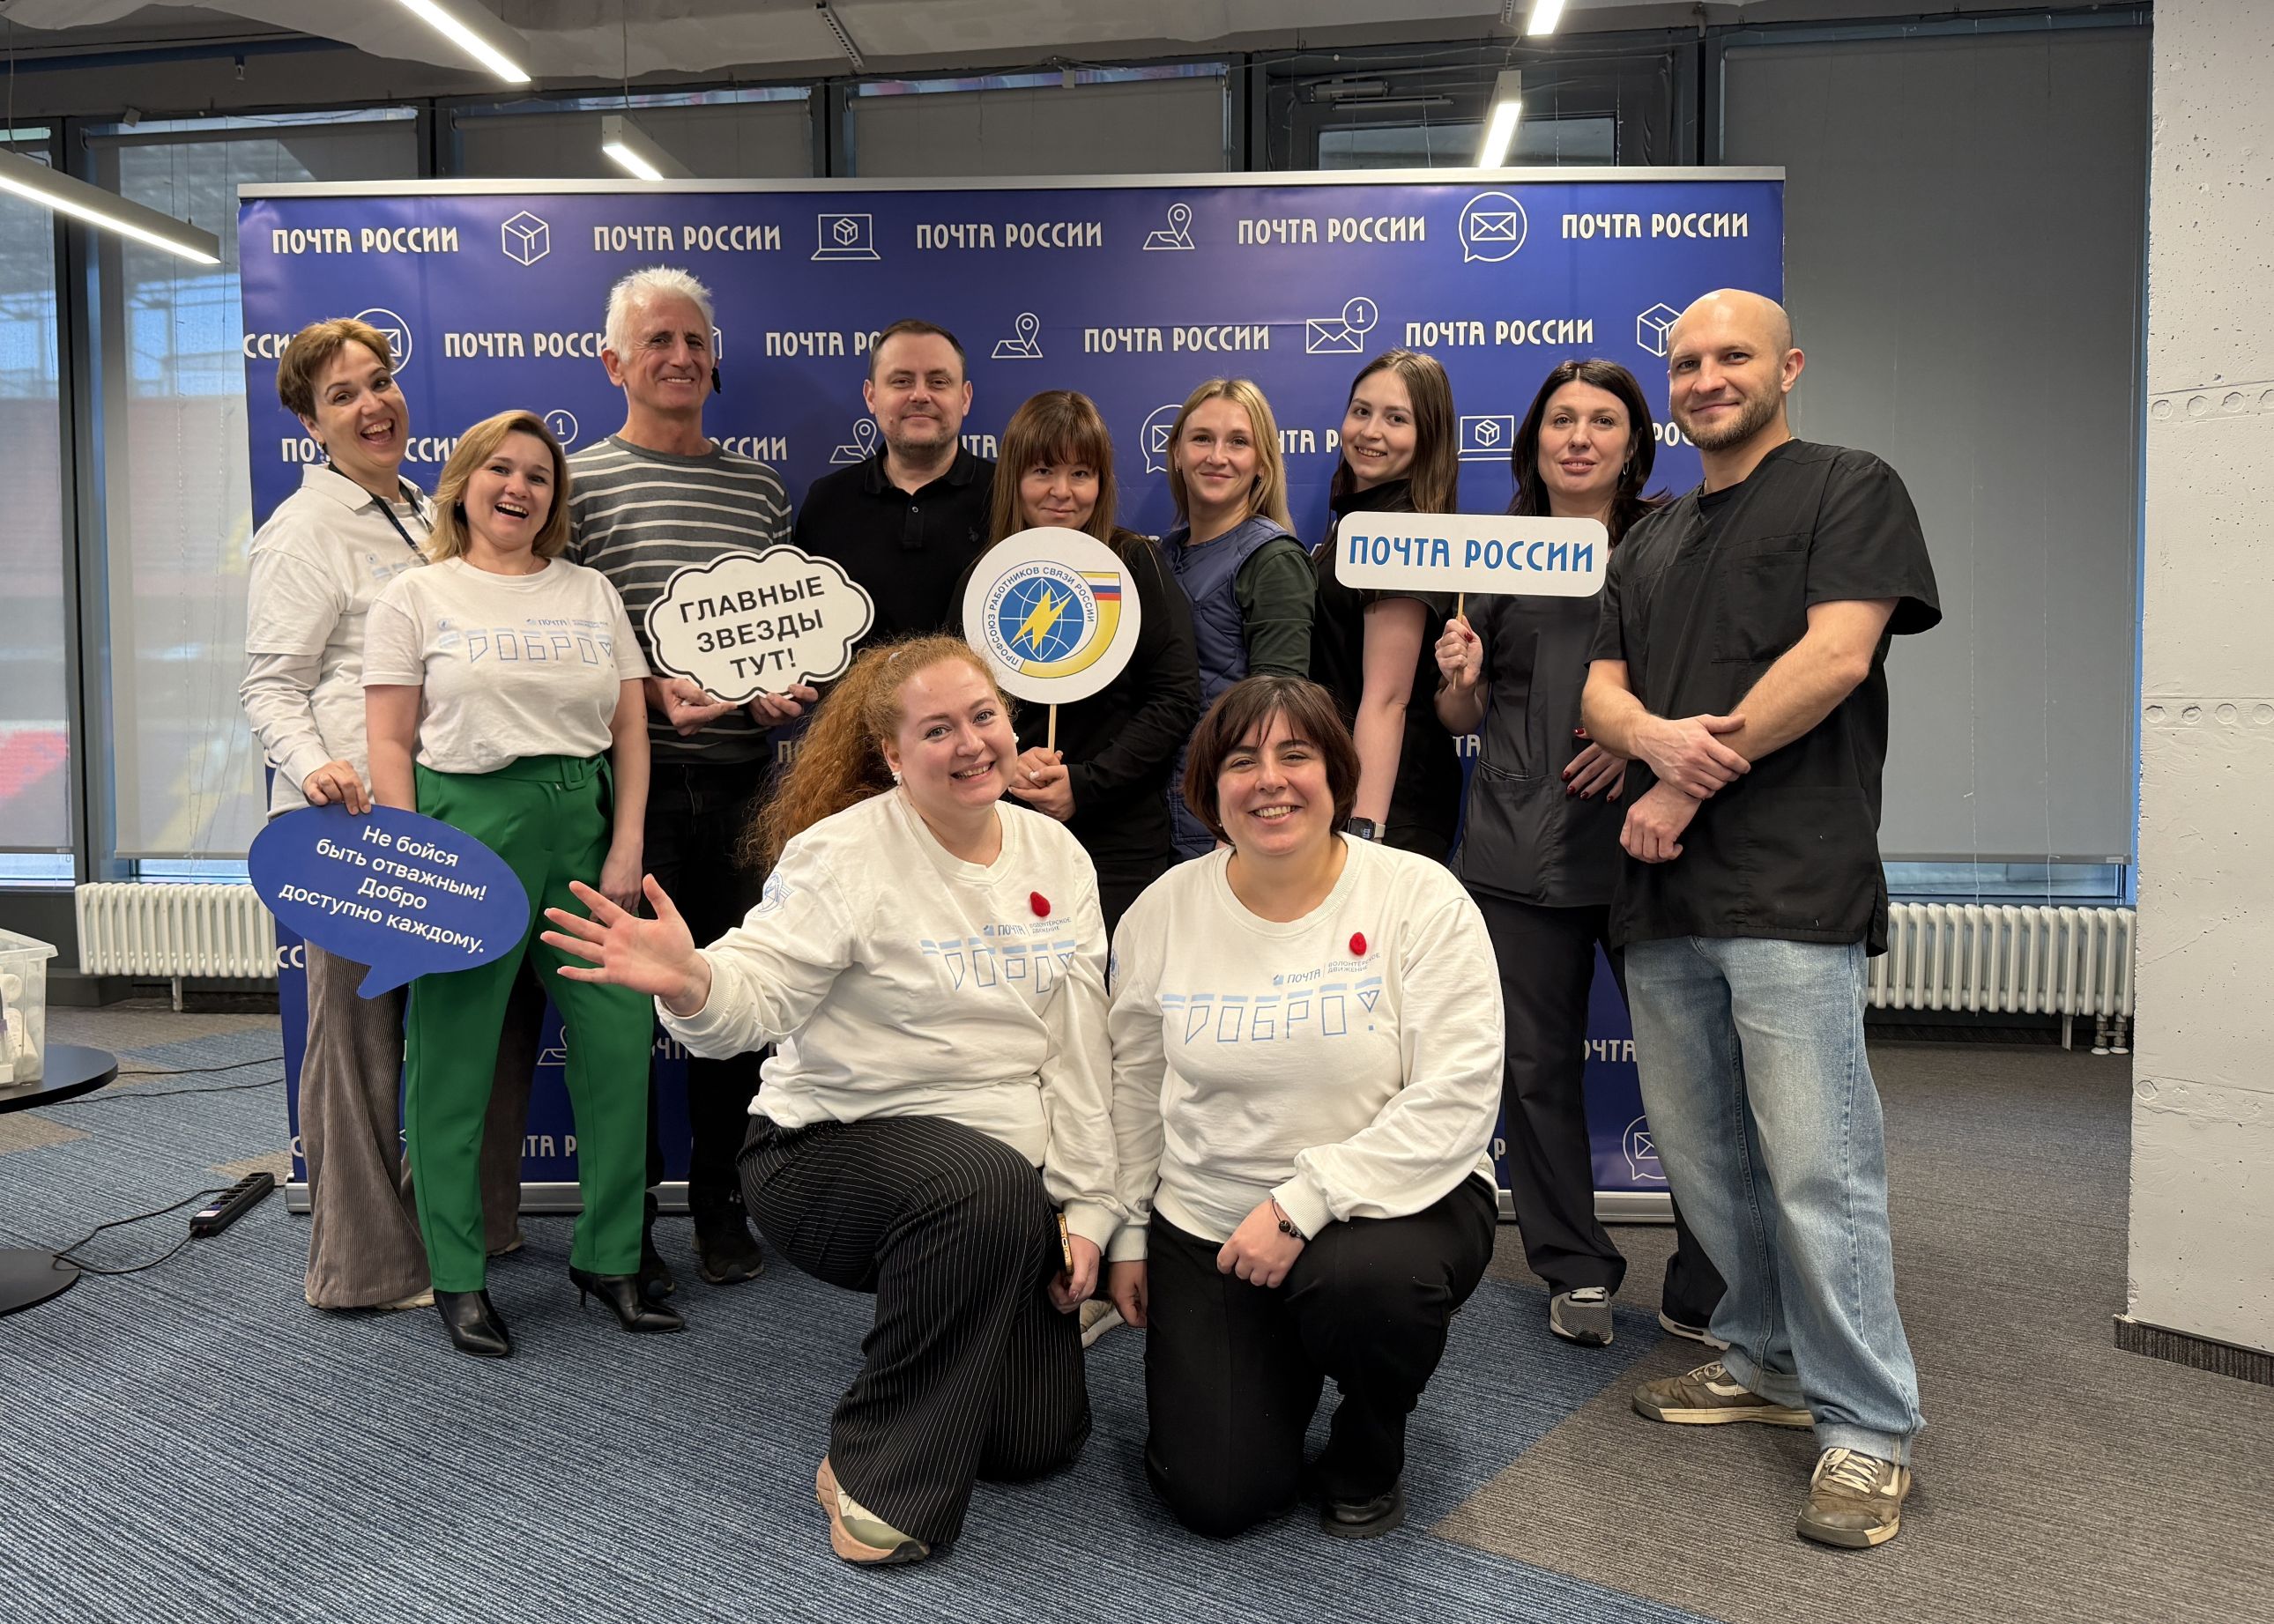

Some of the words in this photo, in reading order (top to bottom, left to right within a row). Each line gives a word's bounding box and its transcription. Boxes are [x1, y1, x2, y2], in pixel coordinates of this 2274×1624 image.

[273, 228, 353, 254] ПОЧТА
[360, 226, 459, 254] РОССИИ
[594, 226, 674, 252] ПОЧТА
[684, 226, 781, 251] РОССИИ
[917, 224, 996, 249] ПОЧТА
[1006, 222, 1102, 248] РОССИИ
[1238, 219, 1318, 245] ПОЧТА
[1327, 216, 1425, 243] РОССИИ
[1562, 213, 1642, 239] ПОЧТА
[1651, 212, 1748, 238] РОССИИ
[444, 332, 524, 358] ПОЧТА
[766, 331, 845, 357] ПОЧТА
[1084, 328, 1163, 353] ПОЧТА
[1173, 325, 1269, 352] РОССИИ
[1405, 321, 1485, 347] ПОЧТА
[1495, 318, 1594, 345] РОССИИ
[1349, 536, 1451, 567] ПОЧТА
[1464, 538, 1594, 573] РОССИИ
[989, 567, 1040, 611] РАБОТНИКОВ
[1043, 567, 1076, 585] СВЯЗИ
[680, 575, 825, 623] ГЛАВНЫЕ
[1074, 583, 1096, 622] РОССИИ
[696, 609, 824, 653] ЗВЕЗДЫ
[987, 613, 1020, 666] ПРОФСОЮЗ
[730, 648, 796, 679] ТУТ!
[362, 825, 393, 848] Не
[396, 835, 459, 867] бойся
[316, 838, 368, 867] быть
[372, 857, 487, 901] отважным!
[358, 877, 428, 910] Добро
[279, 884, 383, 923] доступно
[386, 913, 485, 954] каждому.
[1287, 968, 1320, 983] ПОЧТА
